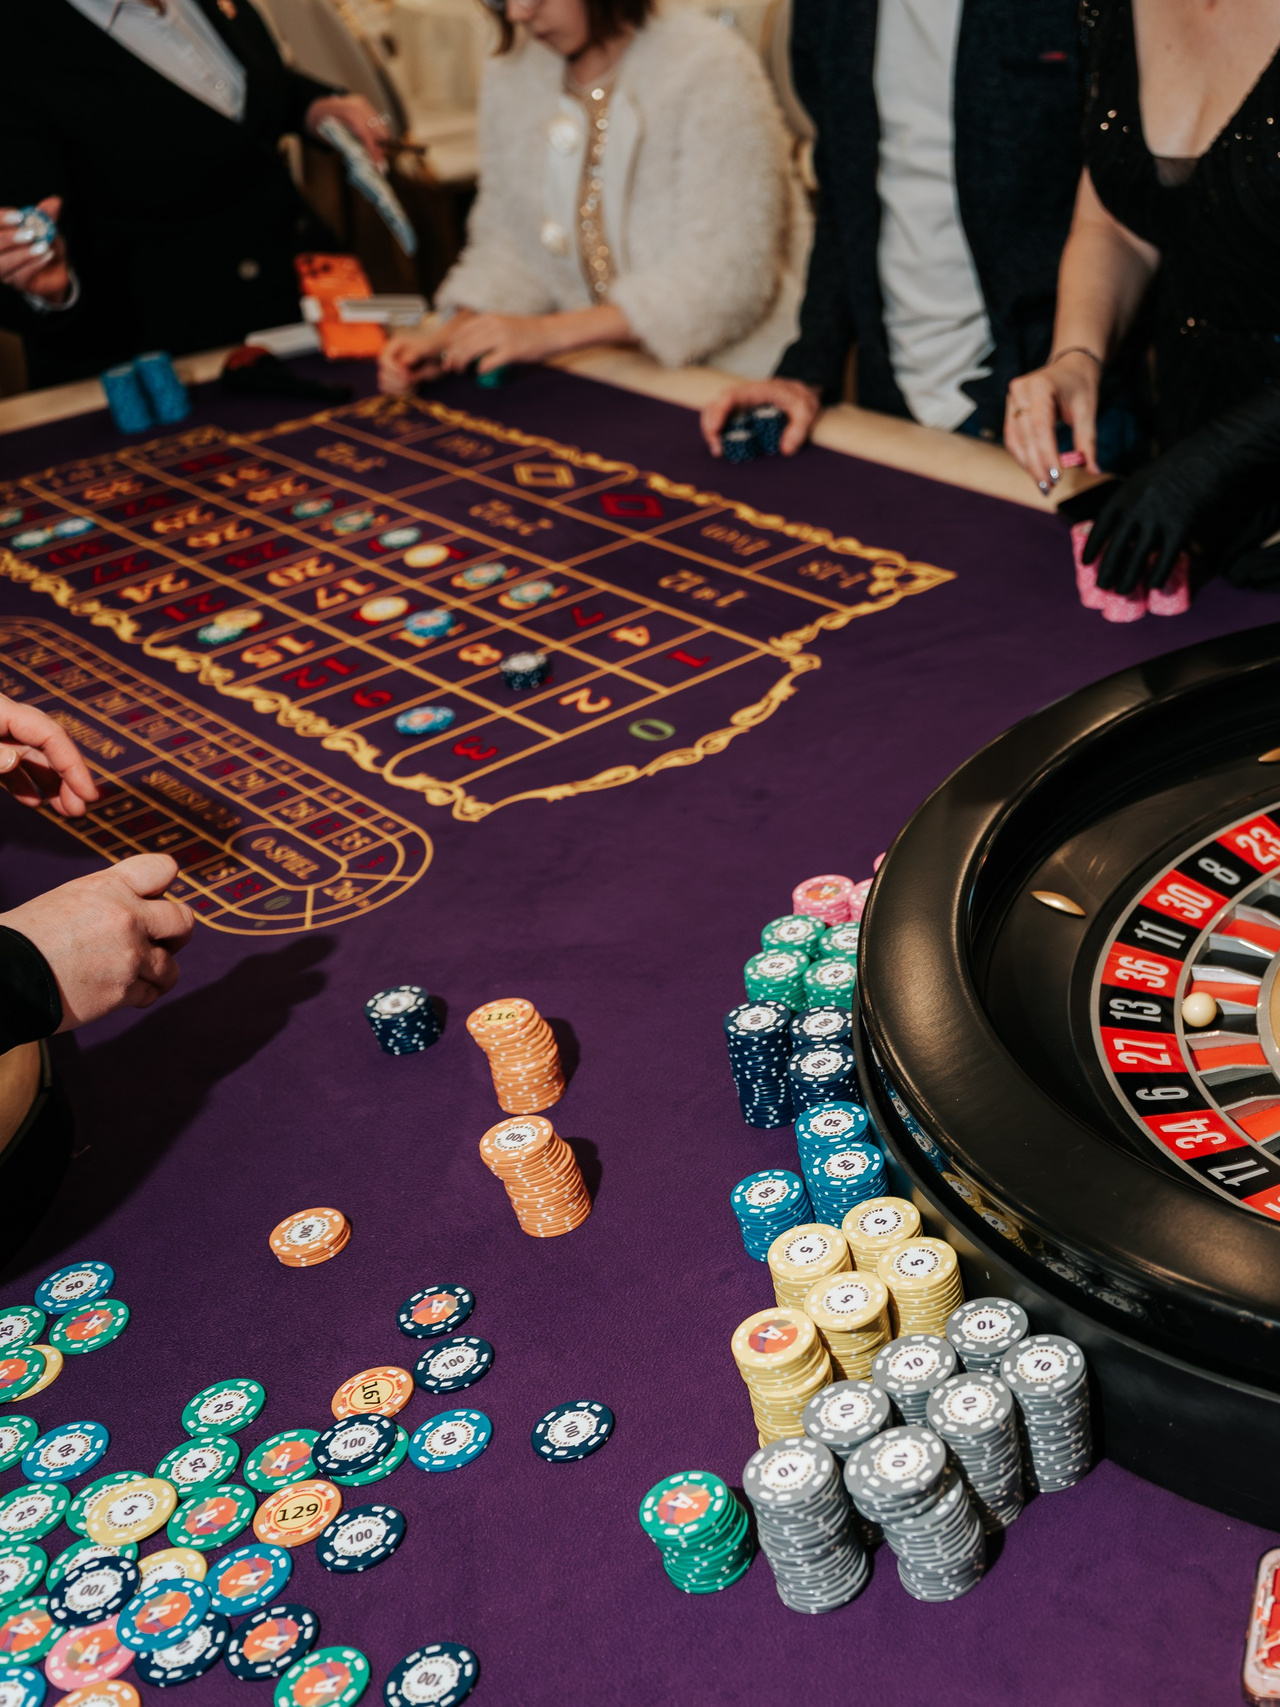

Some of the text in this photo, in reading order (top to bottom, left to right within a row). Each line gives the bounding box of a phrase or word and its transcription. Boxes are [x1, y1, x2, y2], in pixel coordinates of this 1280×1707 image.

[226, 540, 290, 569] 23
[266, 556, 335, 587] 20
[118, 572, 189, 602] 24
[315, 577, 376, 609] 17
[161, 593, 226, 622] 21
[571, 606, 605, 628] 7
[609, 626, 650, 647] 4
[241, 634, 315, 668] 15
[457, 643, 502, 666] 8
[666, 650, 711, 668] 1
[281, 657, 360, 689] 12
[559, 688, 611, 713] 2
[627, 719, 676, 742] 0
[452, 736, 497, 760] 3
[1198, 857, 1240, 885] 8
[1157, 883, 1212, 919] 30
[1134, 920, 1186, 949] 11
[1115, 956, 1169, 988] 36
[486, 1012, 515, 1021] 116
[1109, 998, 1162, 1023] 13
[814, 1015, 833, 1029] 100
[1113, 1037, 1172, 1066] 27
[811, 1057, 831, 1069] 100
[1135, 1087, 1190, 1101] 6
[823, 1118, 842, 1128] 50
[505, 1132, 527, 1143] 500
[1159, 1118, 1227, 1150] 34
[837, 1159, 855, 1171] 50
[1207, 1159, 1270, 1187] 17
[758, 1187, 776, 1199] 50
[873, 1218, 887, 1226] 5
[299, 1224, 314, 1238] 500
[800, 1246, 814, 1254] 5
[910, 1259, 924, 1267] 5
[65, 1280, 84, 1292] 50
[840, 1294, 854, 1304] 5
[977, 1320, 996, 1330] 10
[441, 1355, 465, 1370] 100
[903, 1357, 923, 1370] 10
[1033, 1359, 1051, 1371] 10
[361, 1381, 381, 1405] 167
[213, 1401, 233, 1414] 25
[840, 1403, 854, 1418] 10
[962, 1397, 977, 1411] 10
[563, 1420, 580, 1438] 100
[342, 1436, 366, 1449] 100
[441, 1431, 457, 1446] 50
[58, 1443, 75, 1458] 50
[189, 1458, 206, 1472] 25
[892, 1453, 908, 1467] 10
[777, 1463, 798, 1477] 10
[15, 1505, 37, 1522] 25
[124, 1505, 138, 1516] 5
[277, 1503, 319, 1522] 129
[347, 1528, 373, 1545] 100
[79, 1584, 106, 1597] 100
[416, 1672, 443, 1687] 100
